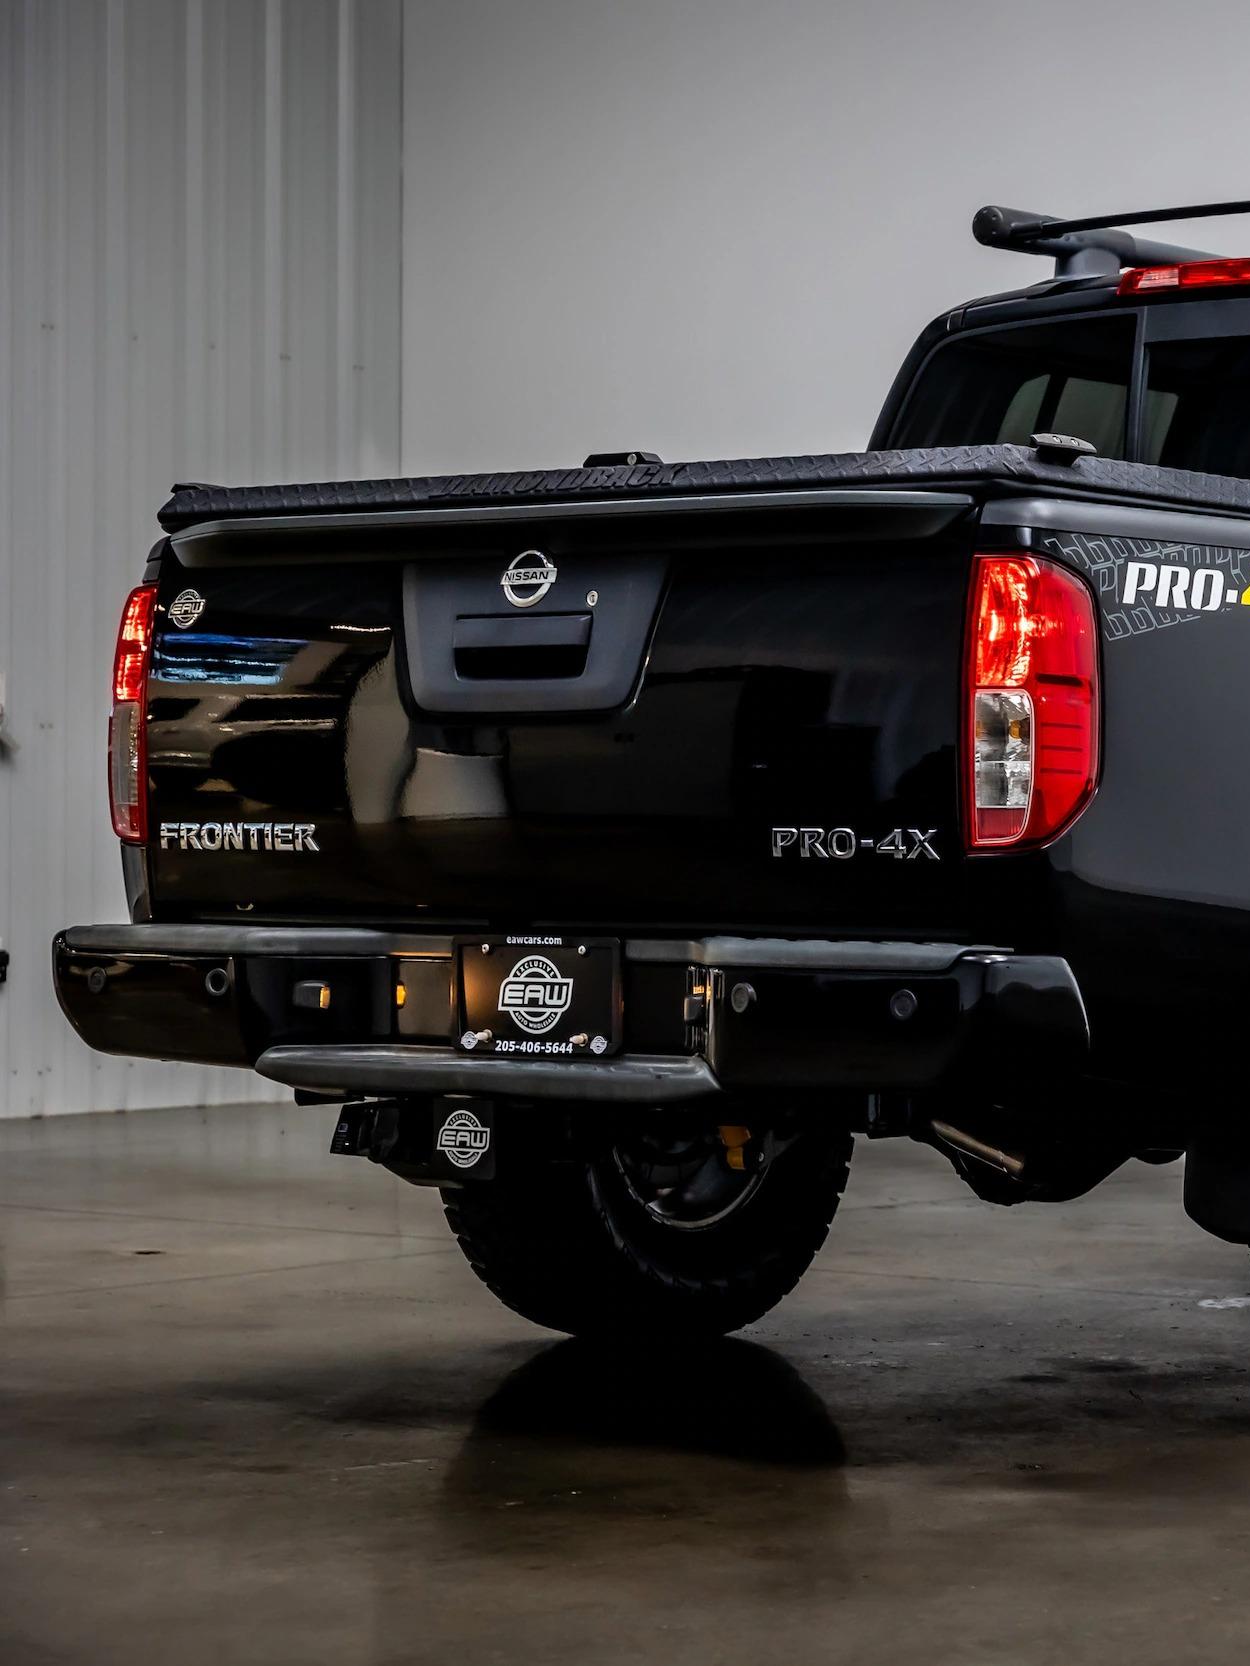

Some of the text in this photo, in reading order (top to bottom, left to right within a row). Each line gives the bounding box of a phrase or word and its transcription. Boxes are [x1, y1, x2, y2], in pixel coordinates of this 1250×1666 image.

[504, 571, 549, 582] NISSAN
[171, 602, 202, 615] EAW
[160, 822, 321, 853] FRONTIER
[771, 827, 941, 861] PRO-4X
[506, 936, 562, 945] eawcars.com
[515, 960, 555, 978] EXCLUSIVE
[503, 984, 568, 1006] EAW
[514, 1011, 529, 1026] AUTO
[495, 1040, 573, 1054] 205-406-5644
[441, 1130, 487, 1147] EAW
